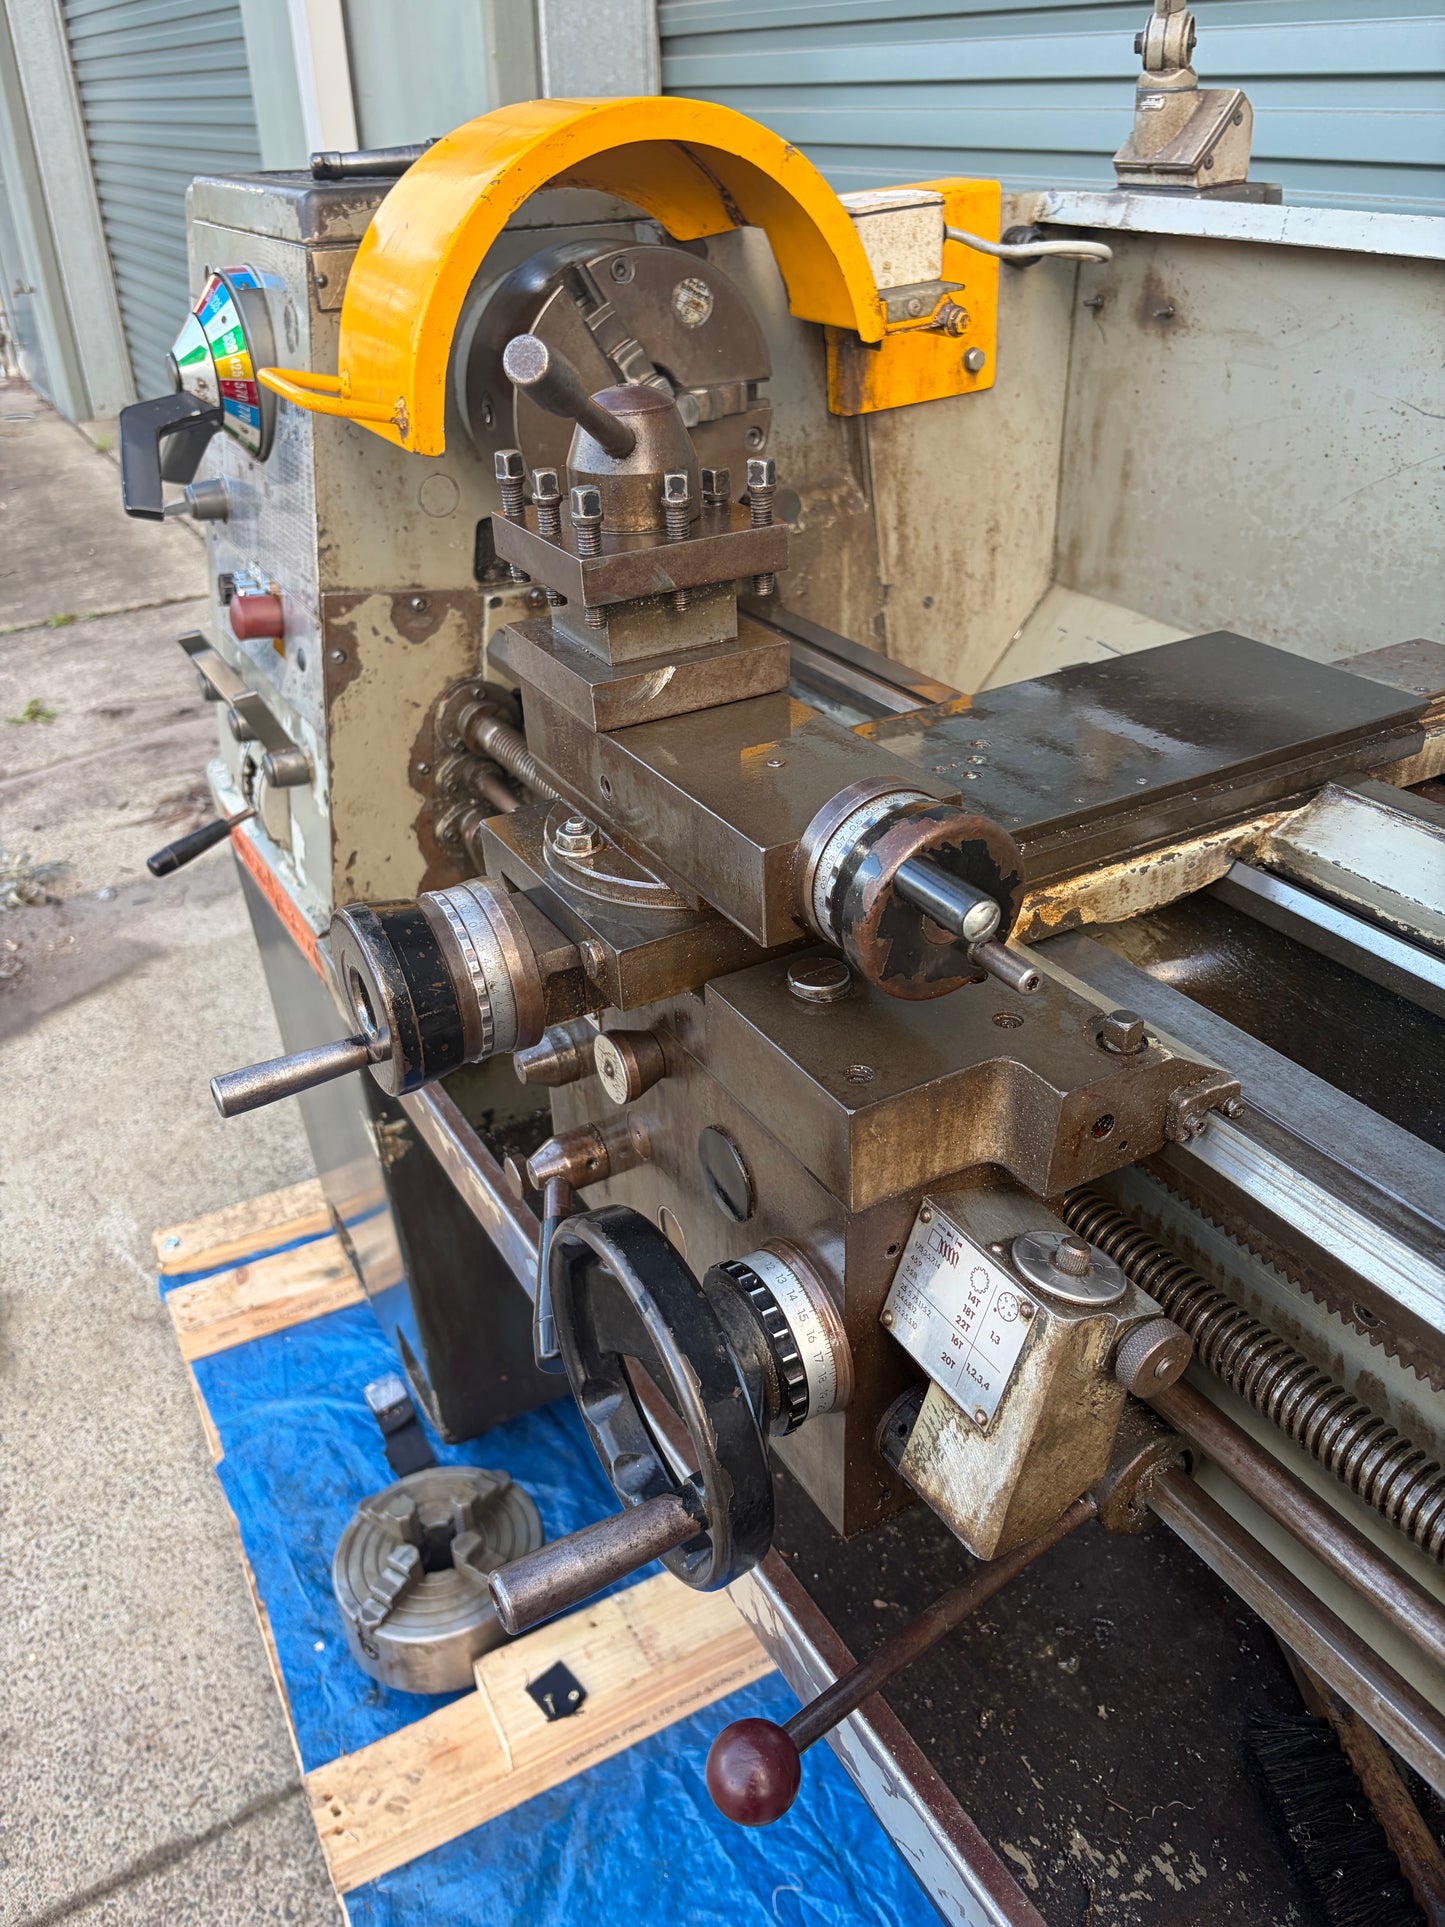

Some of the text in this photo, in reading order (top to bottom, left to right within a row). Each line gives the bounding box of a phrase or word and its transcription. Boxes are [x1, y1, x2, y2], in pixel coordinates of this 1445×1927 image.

[764, 1261, 776, 1271] 12
[775, 1272, 788, 1285] 13
[786, 1288, 798, 1302] 14
[967, 1291, 982, 1308] 14T
[797, 1308, 810, 1322] 15
[962, 1303, 976, 1321] 18T
[954, 1314, 972, 1333] 22T
[806, 1328, 818, 1344] 16
[950, 1333, 964, 1350] 16T
[989, 1330, 1001, 1346] 1,3
[813, 1350, 825, 1364] 17
[940, 1351, 956, 1370] 20T
[817, 1371, 828, 1384] 18
[965, 1362, 991, 1392] 1,2,3,4
